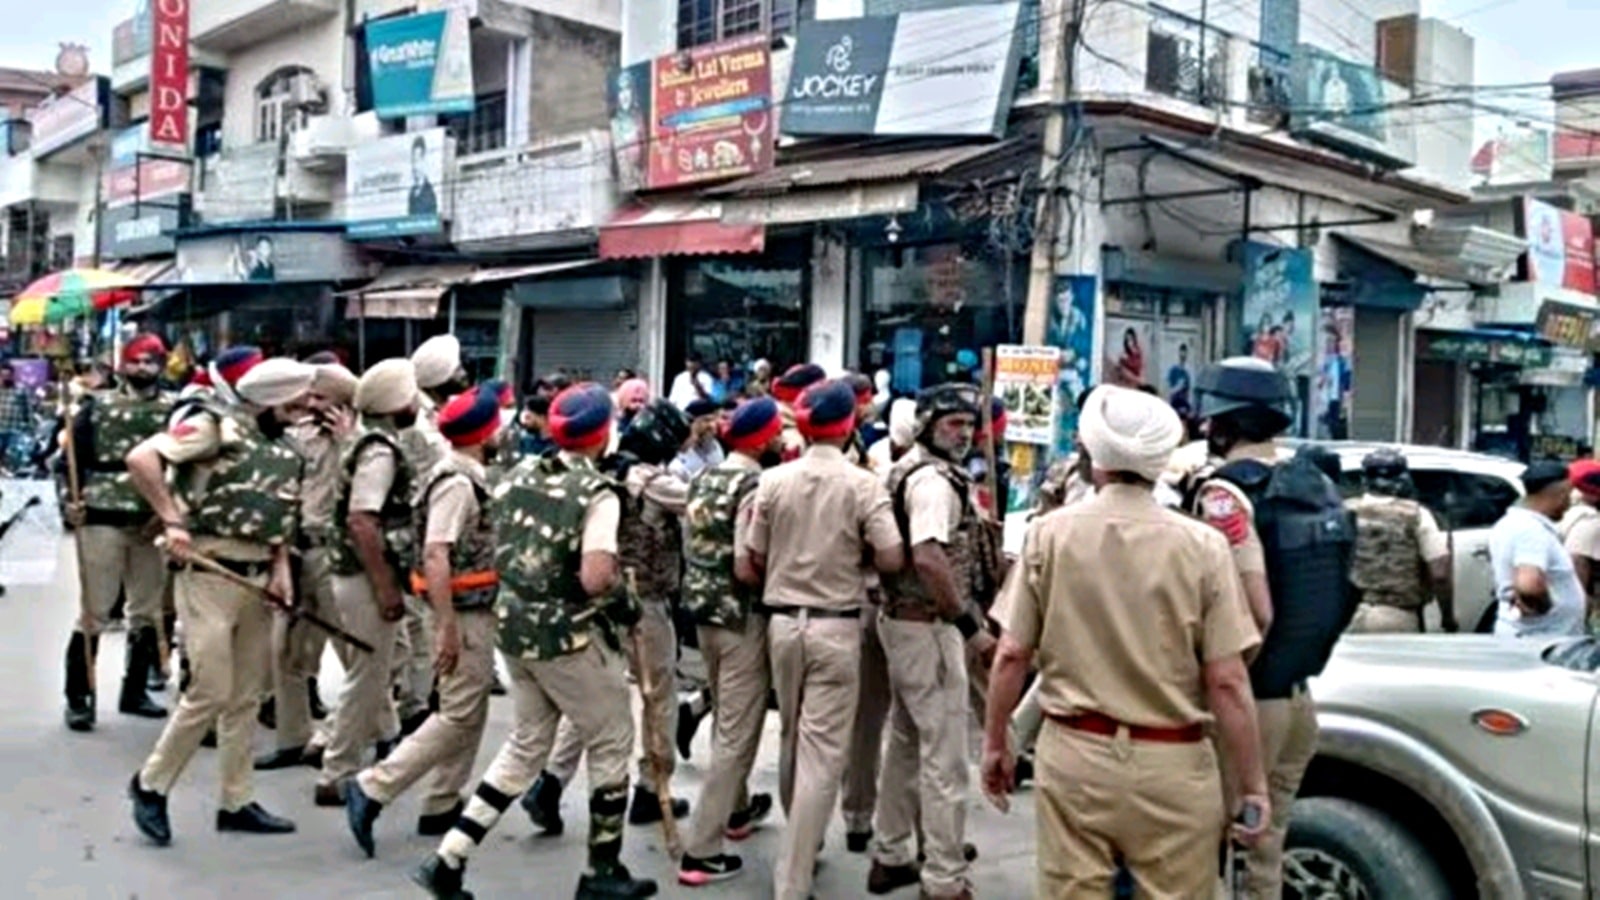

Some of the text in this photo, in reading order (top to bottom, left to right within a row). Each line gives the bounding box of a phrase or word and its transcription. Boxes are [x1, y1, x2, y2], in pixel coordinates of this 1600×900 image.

[158, 0, 184, 139] ONIDA
[698, 58, 718, 79] Lal
[793, 73, 878, 98] JOCKEY
